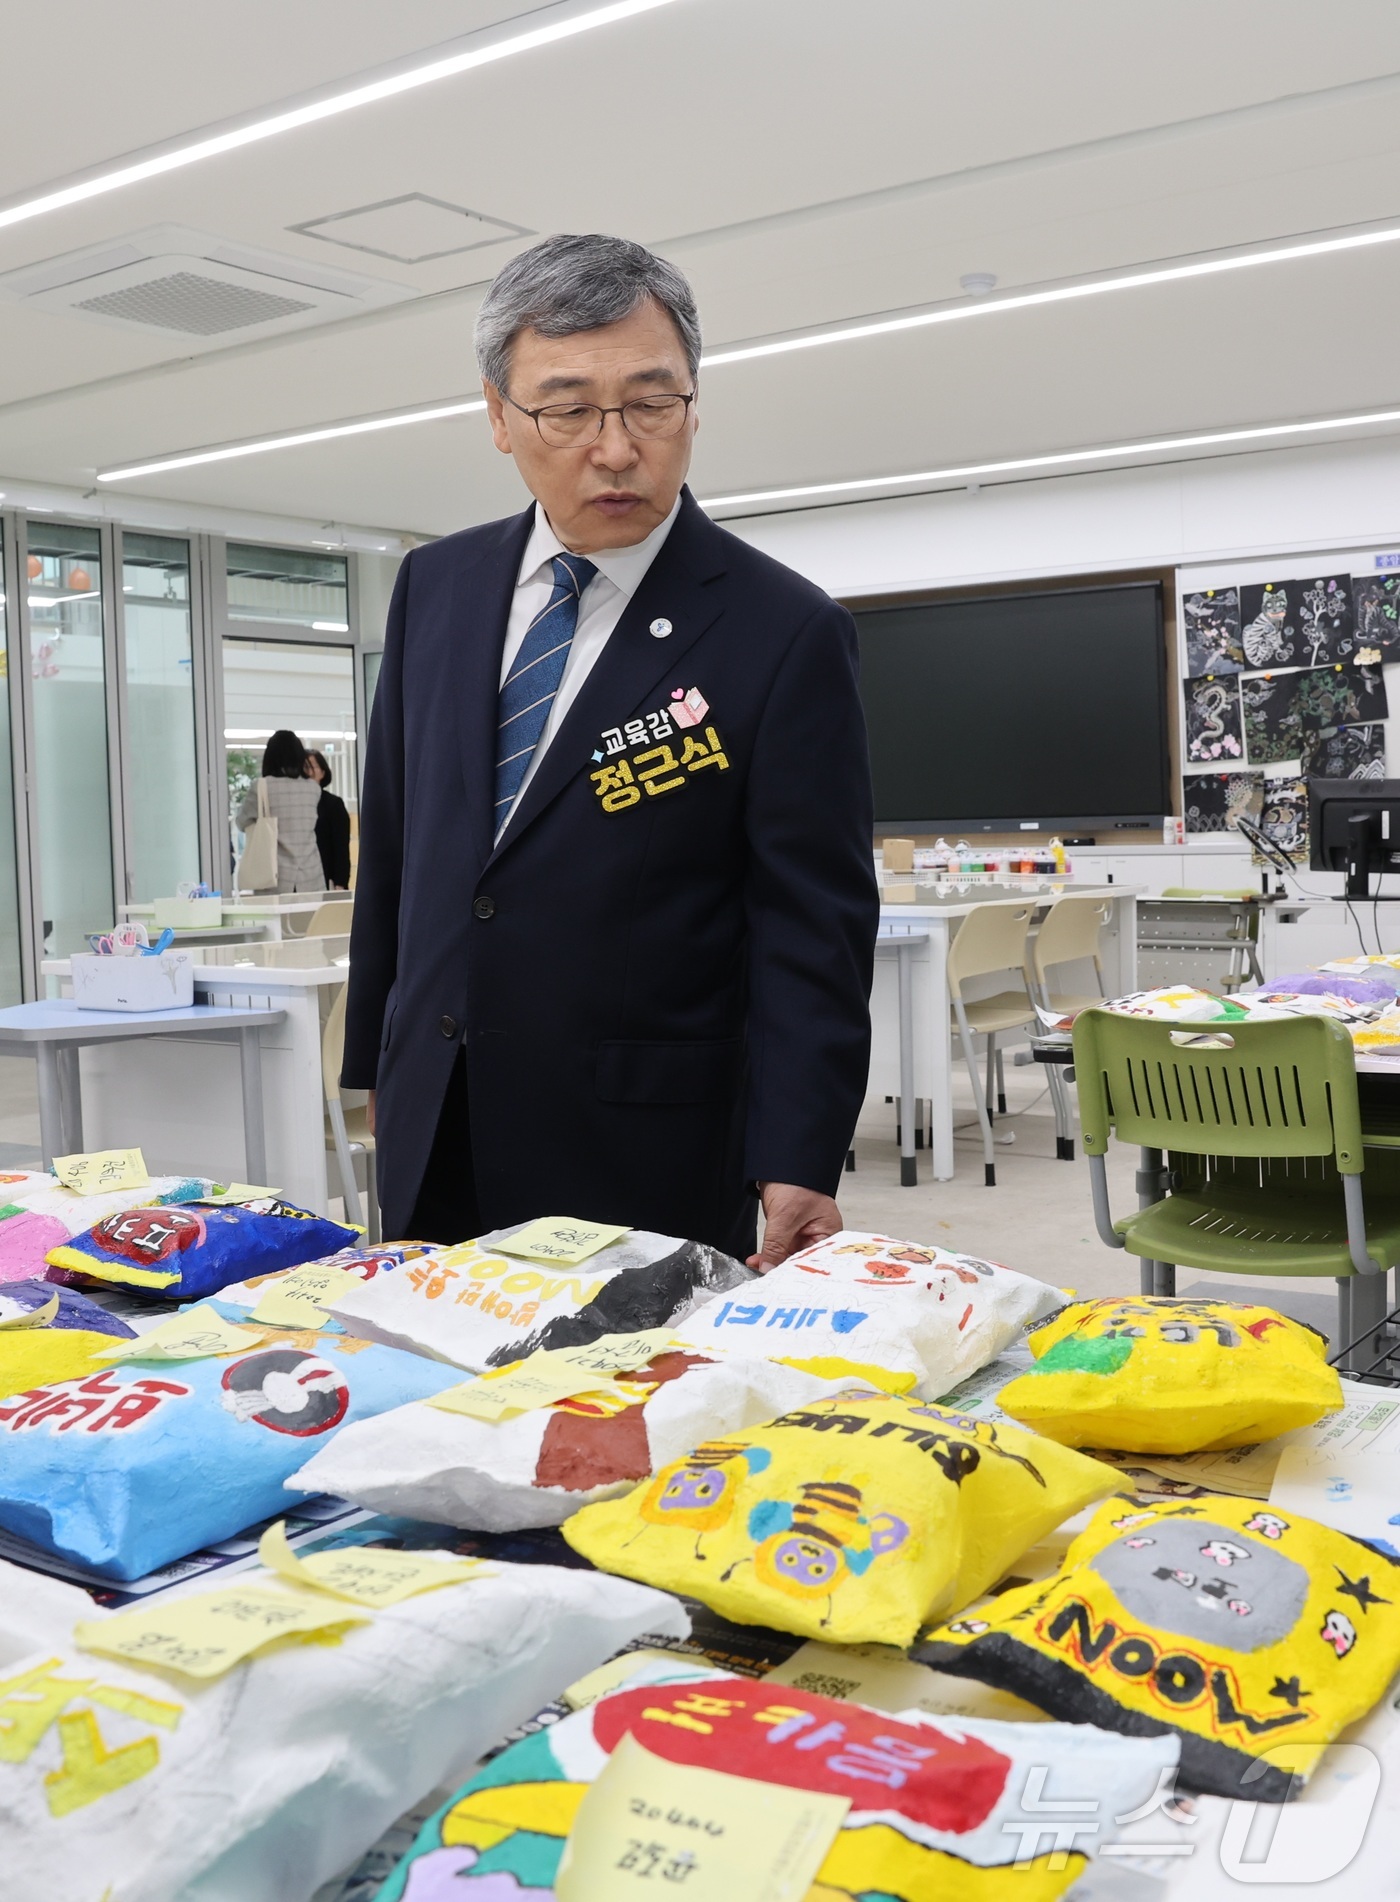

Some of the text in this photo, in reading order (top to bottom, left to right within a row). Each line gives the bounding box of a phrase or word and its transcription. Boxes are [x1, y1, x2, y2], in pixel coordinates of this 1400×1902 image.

[589, 726, 730, 813] 정근식
[601, 709, 673, 756] 교육감
[1047, 1606, 1309, 1732] MOON
